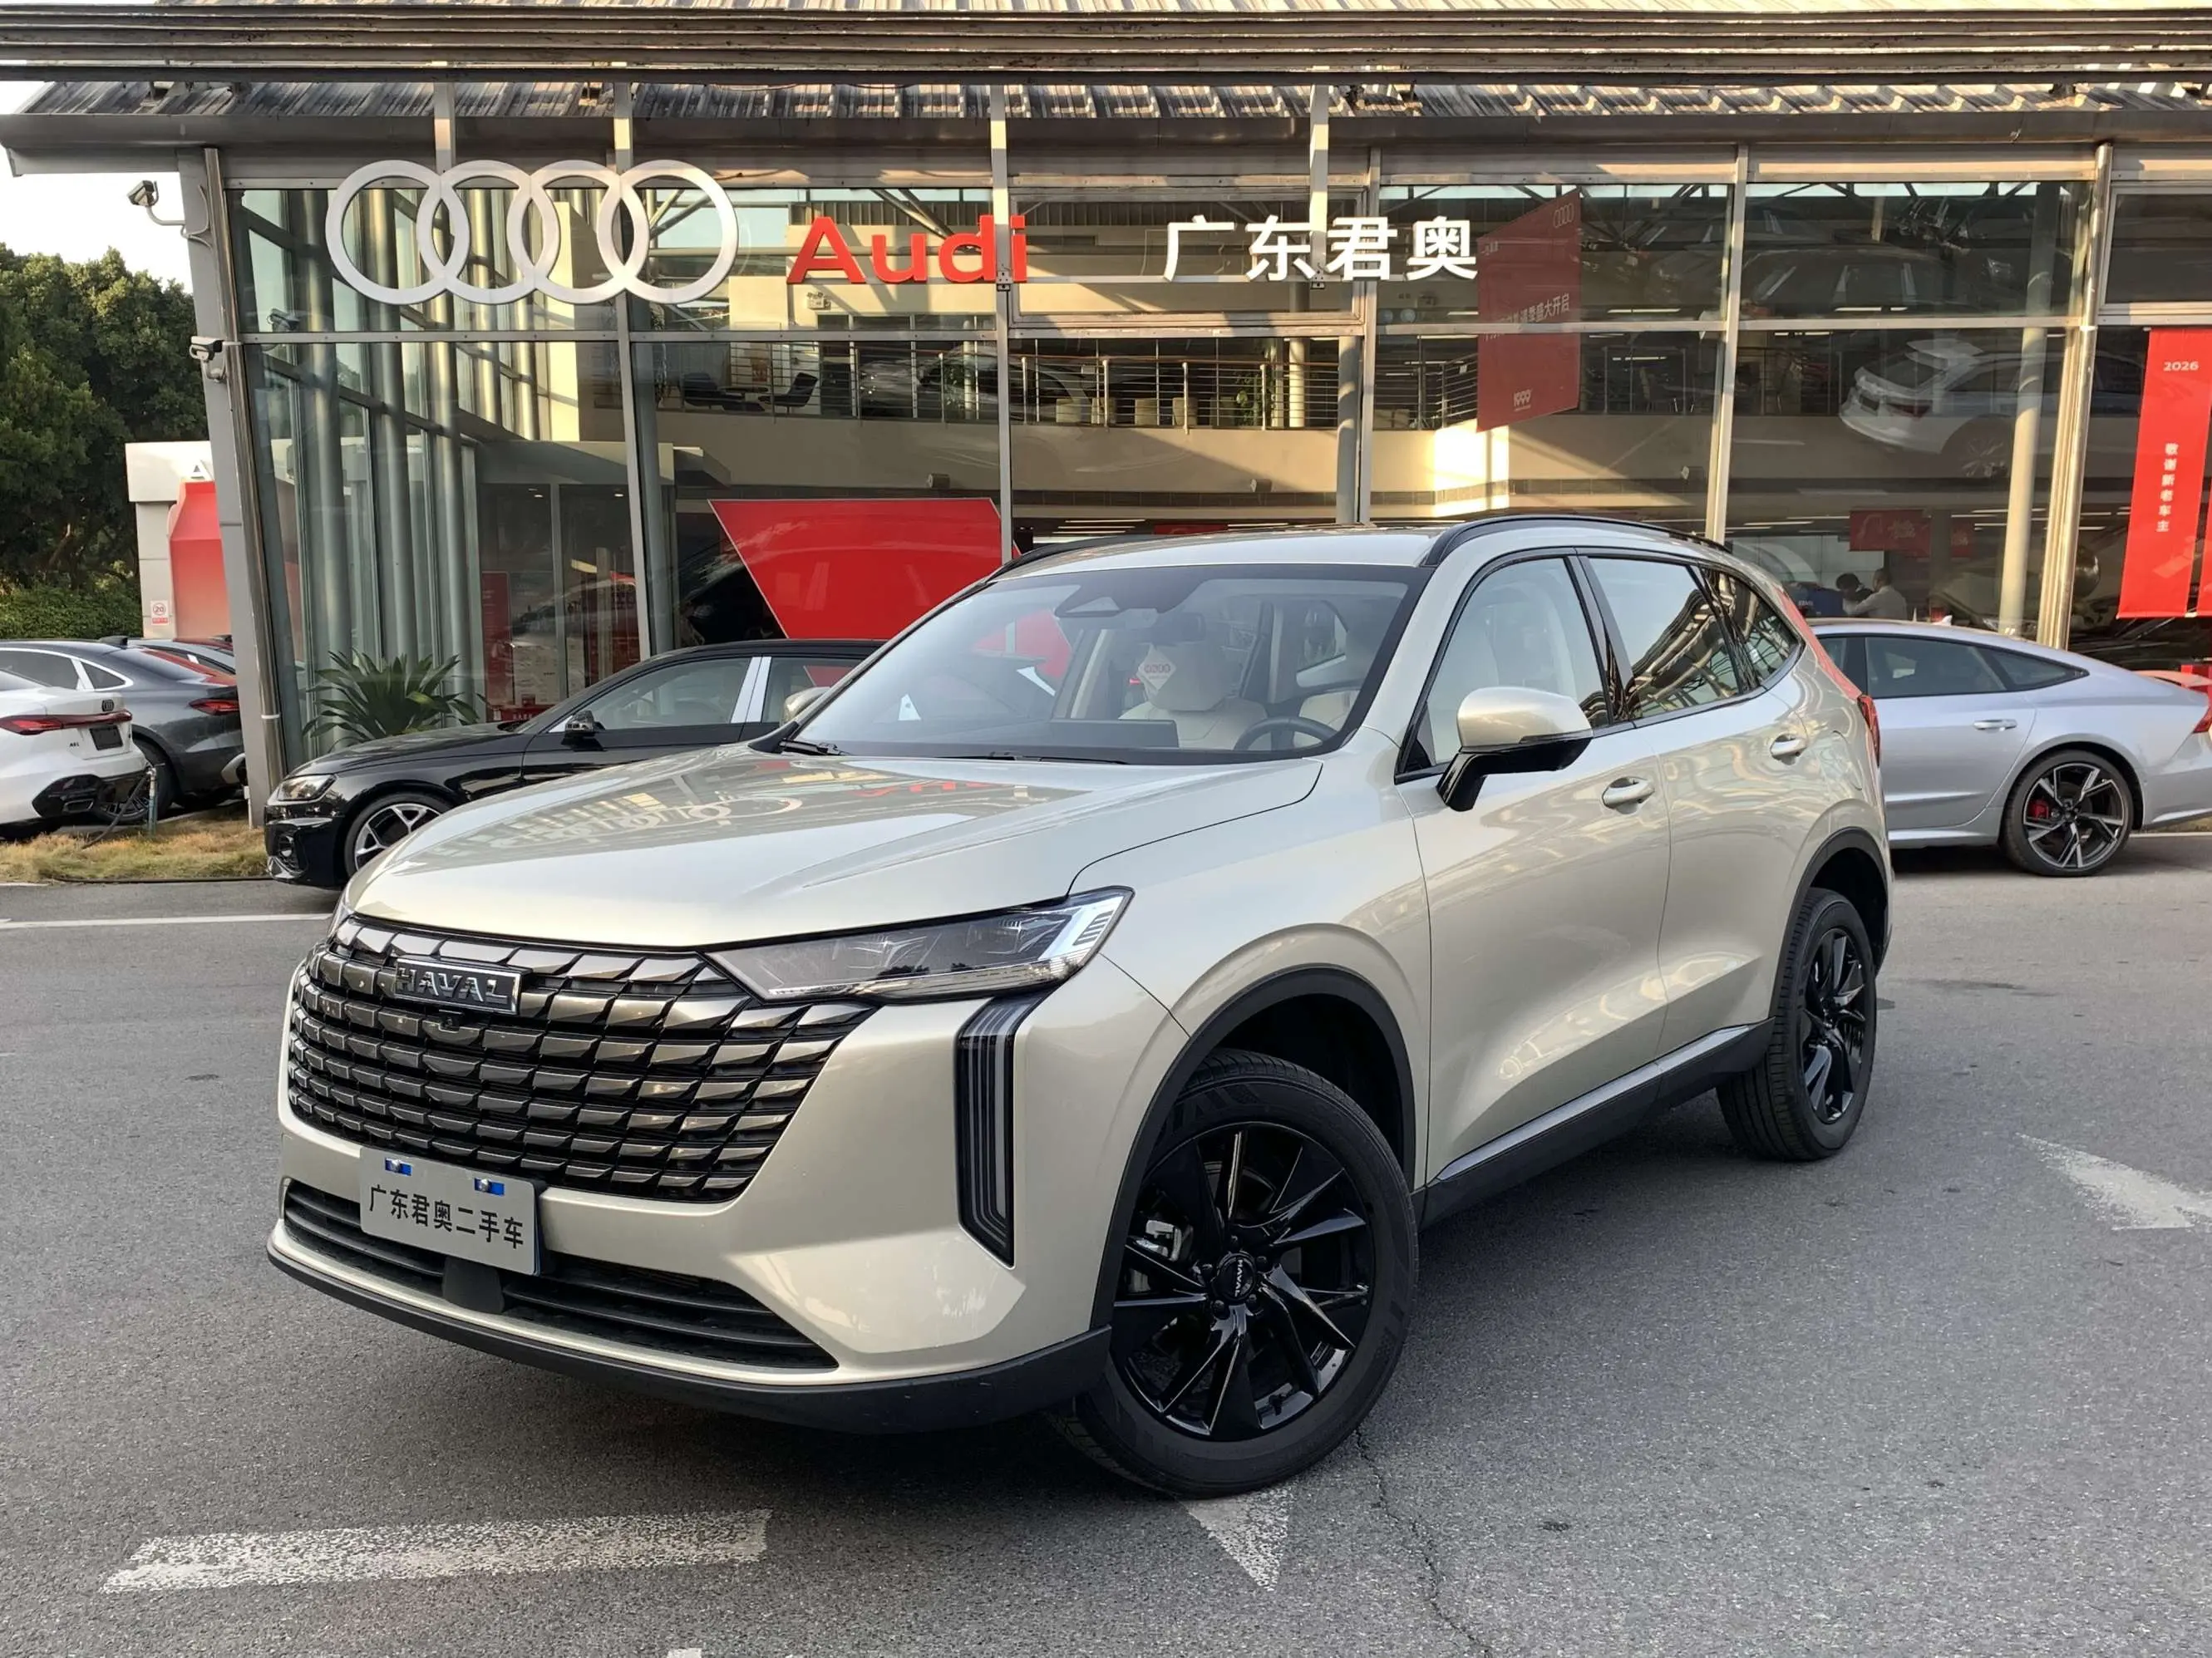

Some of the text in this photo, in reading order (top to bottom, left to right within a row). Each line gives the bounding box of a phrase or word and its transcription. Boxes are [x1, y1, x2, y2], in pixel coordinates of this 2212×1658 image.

[786, 214, 1027, 283] Audi
[1163, 214, 1478, 282] 广东君奥
[2164, 361, 2199, 371] 2026
[397, 967, 508, 1005] HAVAL
[370, 1184, 524, 1249] 广东君奥二手车
[1234, 1260, 1243, 1296] HAVAL
